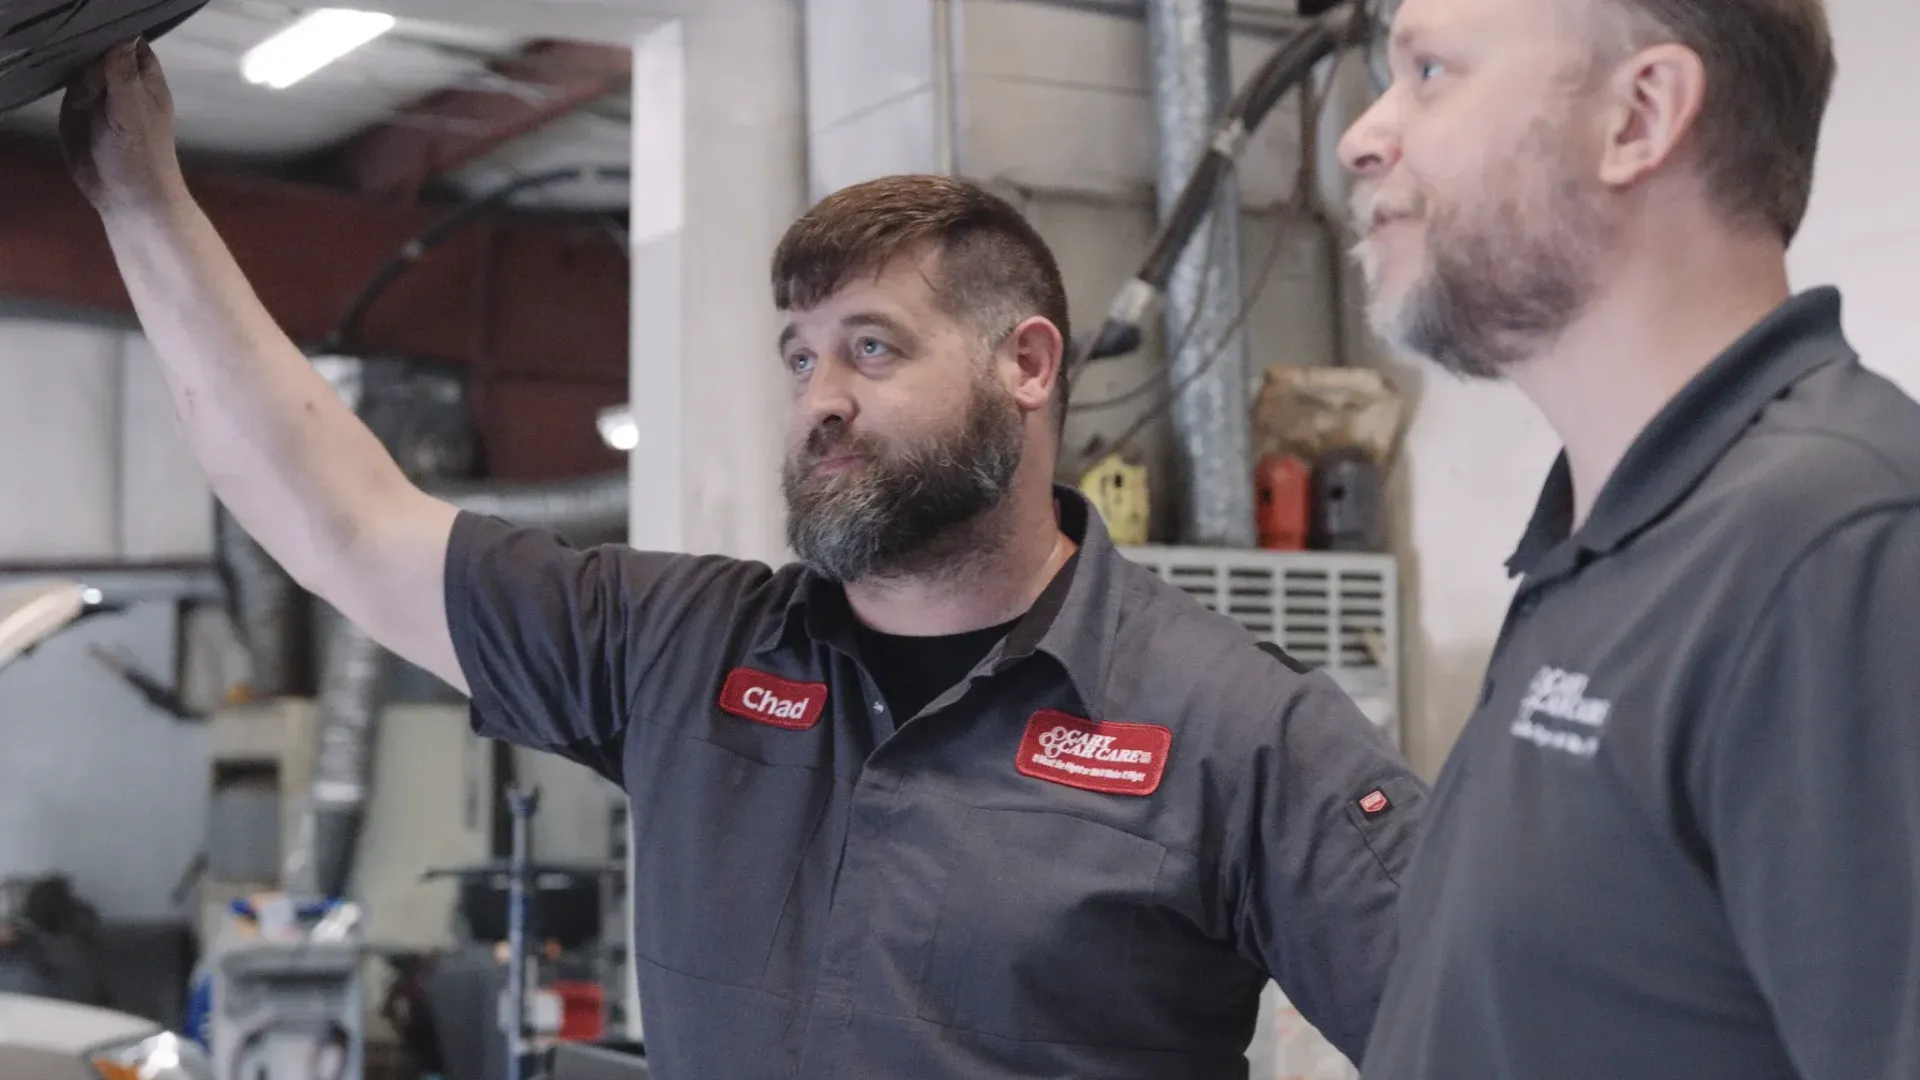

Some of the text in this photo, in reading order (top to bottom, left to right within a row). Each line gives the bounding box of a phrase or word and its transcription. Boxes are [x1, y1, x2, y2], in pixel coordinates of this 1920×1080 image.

[742, 686, 809, 719] Chad
[1066, 729, 1117, 748] CARY
[1059, 741, 1097, 759] CAR
[1095, 748, 1142, 763] CARE
